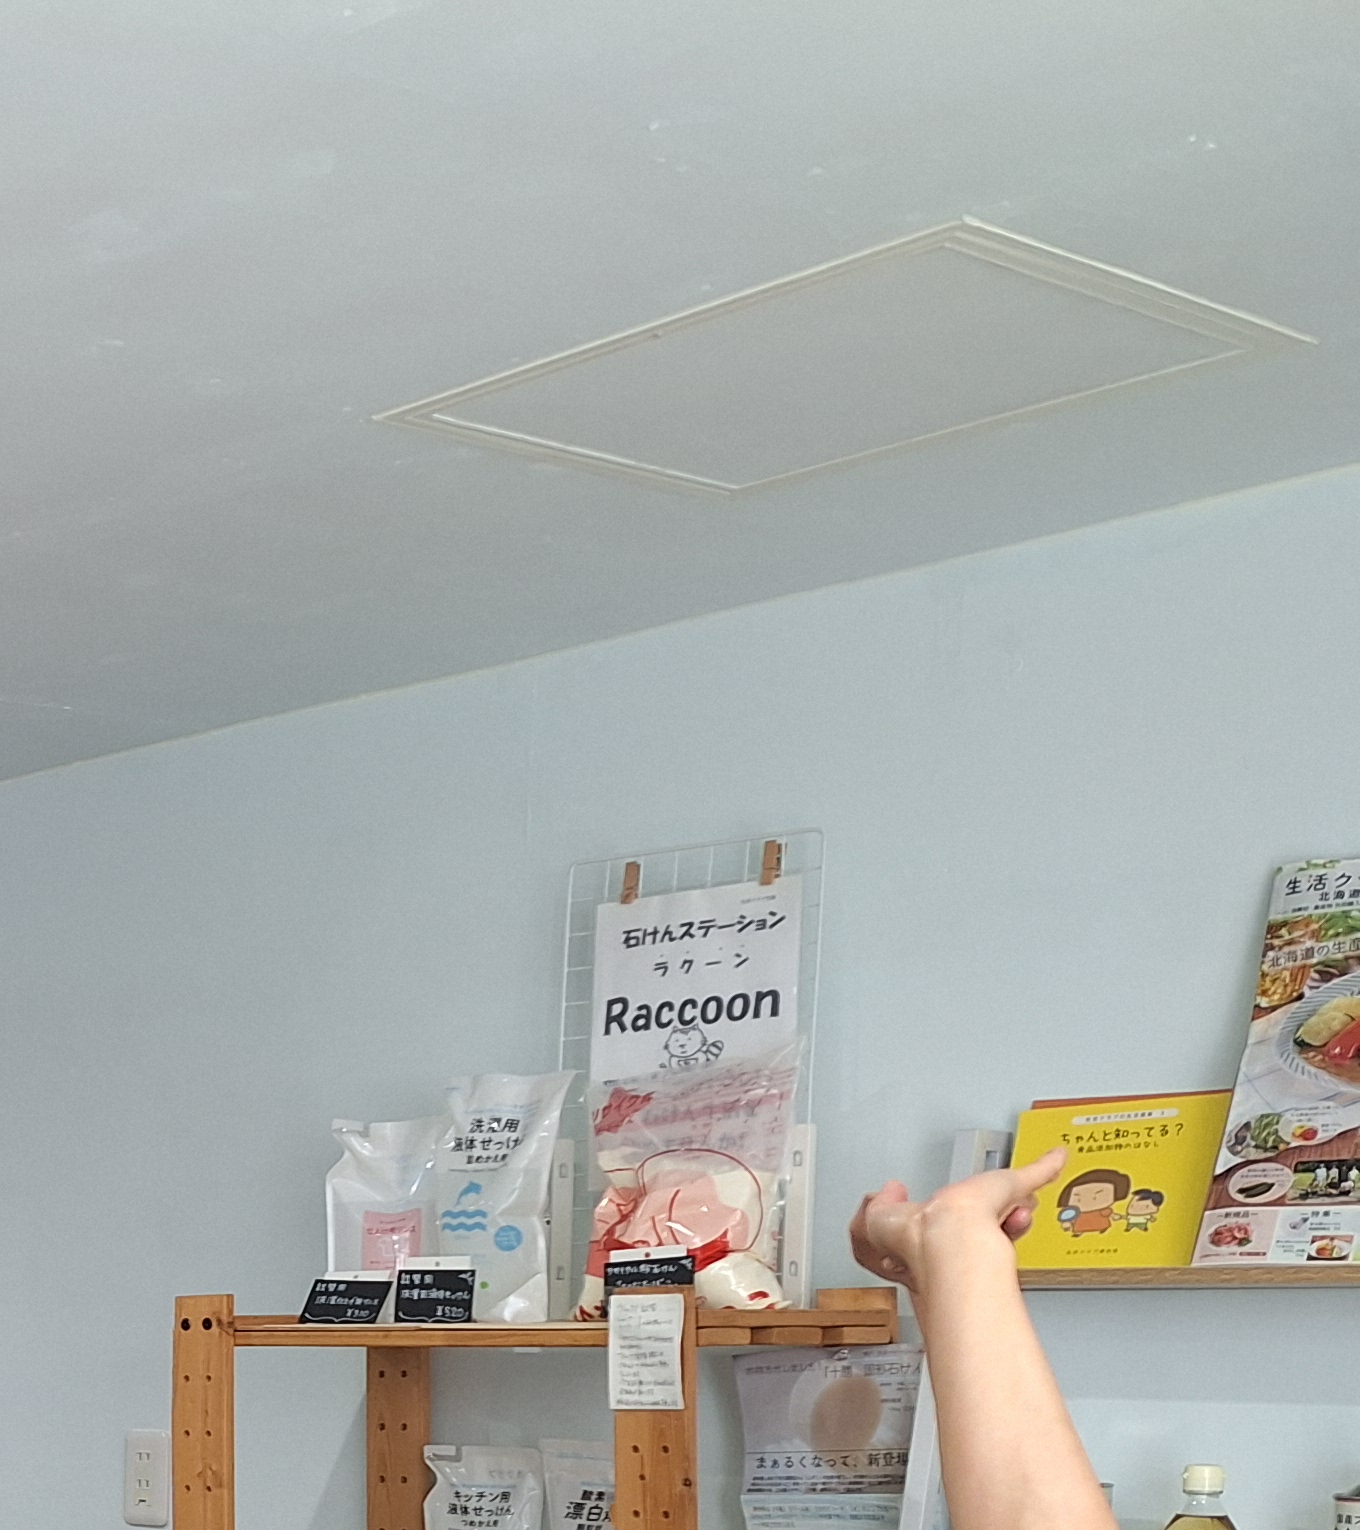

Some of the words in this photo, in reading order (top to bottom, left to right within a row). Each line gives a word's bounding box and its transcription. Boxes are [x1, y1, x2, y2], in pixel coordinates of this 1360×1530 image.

[1285, 872, 1360, 896] 生活ク
[621, 911, 787, 949] 石けんステーション
[653, 953, 750, 978] ラクーン
[602, 989, 781, 1037] Raccoon
[1061, 1123, 1184, 1145] ちゃんと知ってる？
[453, 1490, 512, 1503] キッチン用
